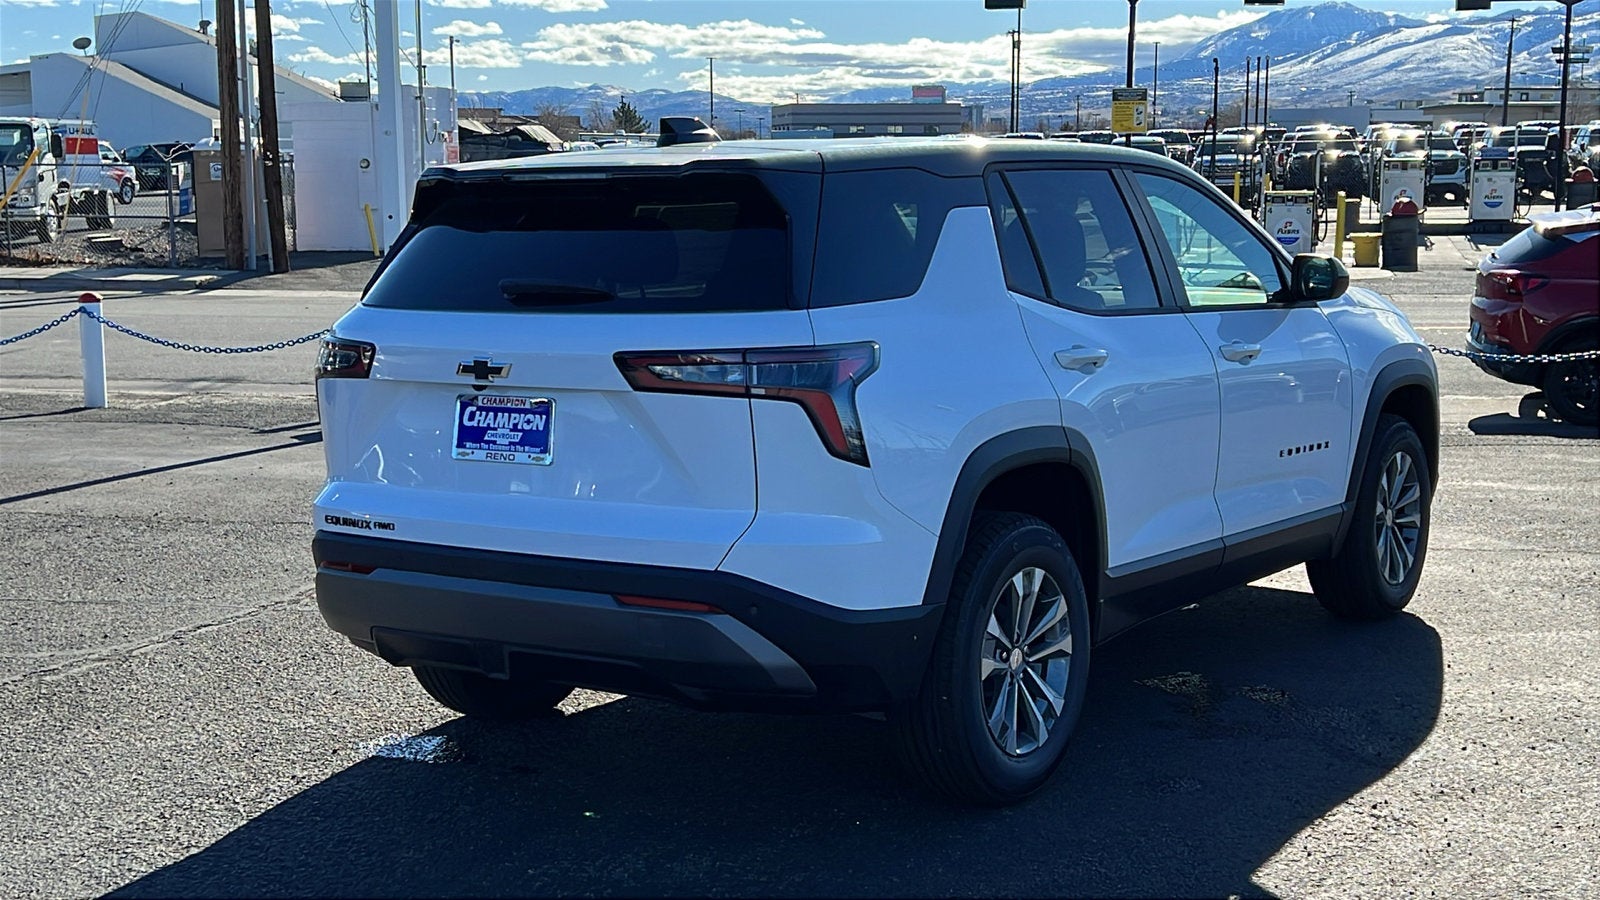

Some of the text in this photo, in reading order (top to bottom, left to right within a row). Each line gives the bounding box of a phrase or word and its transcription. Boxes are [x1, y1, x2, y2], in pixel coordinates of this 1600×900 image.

[481, 397, 526, 407] CHAMPION
[463, 406, 546, 430] CHAMPION
[487, 432, 519, 440] CHEVROLET
[1280, 441, 1329, 457] EQUINOX
[486, 452, 515, 461] RENO
[325, 515, 395, 530] EQUINOX AWD
